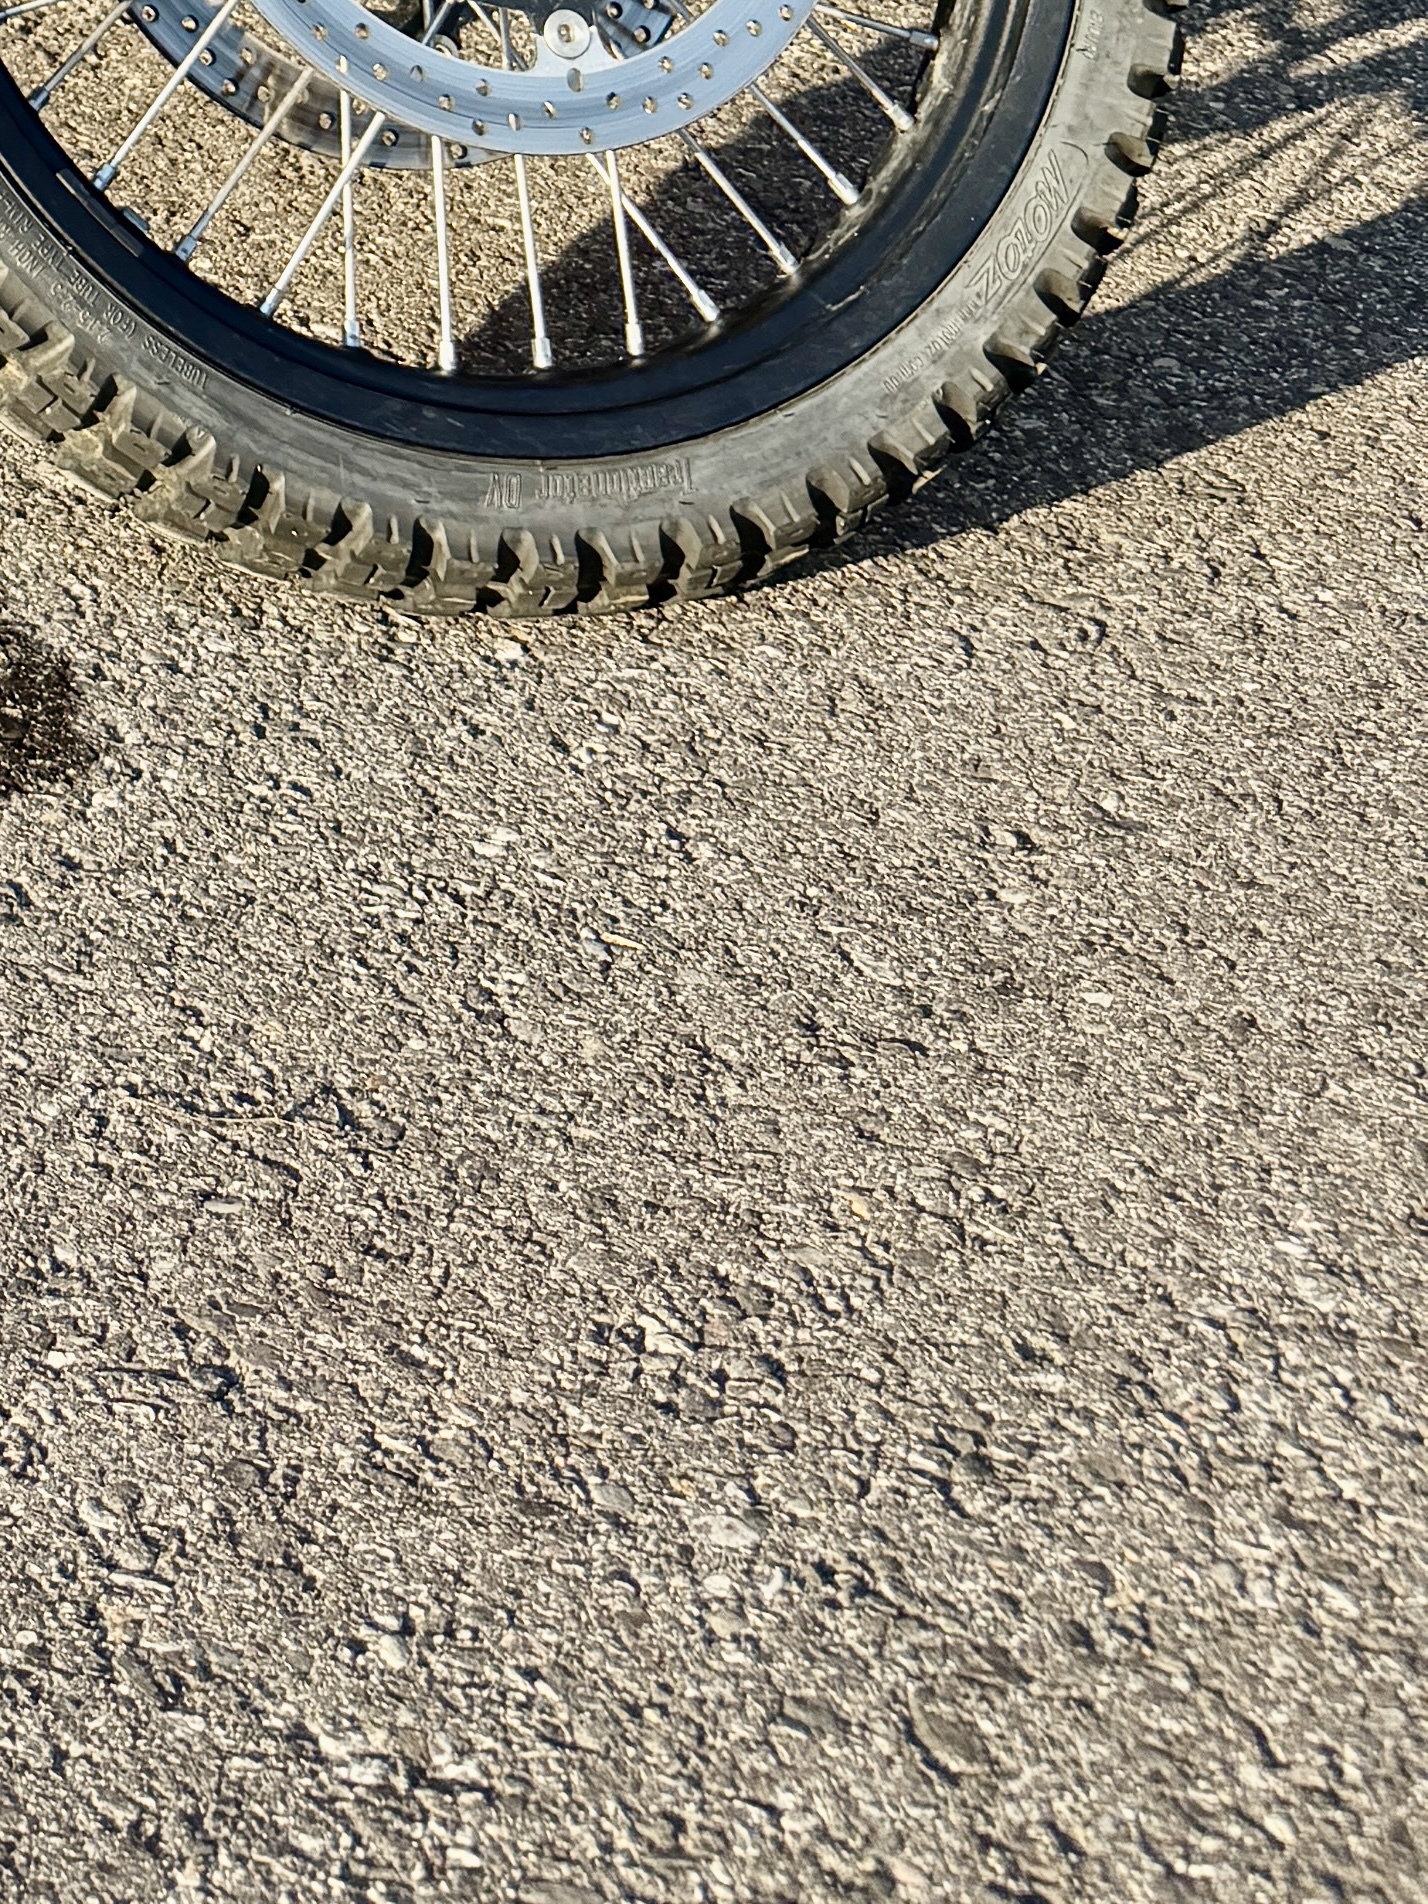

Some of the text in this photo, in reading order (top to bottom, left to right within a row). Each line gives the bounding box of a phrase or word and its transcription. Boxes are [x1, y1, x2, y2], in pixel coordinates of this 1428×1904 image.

[964, 149, 1069, 304] MOTOZ
[30, 232, 62, 273] TYPE
[65, 268, 99, 307] TUBE
[101, 299, 134, 341] (FOR
[140, 332, 208, 390] TUBELESS
